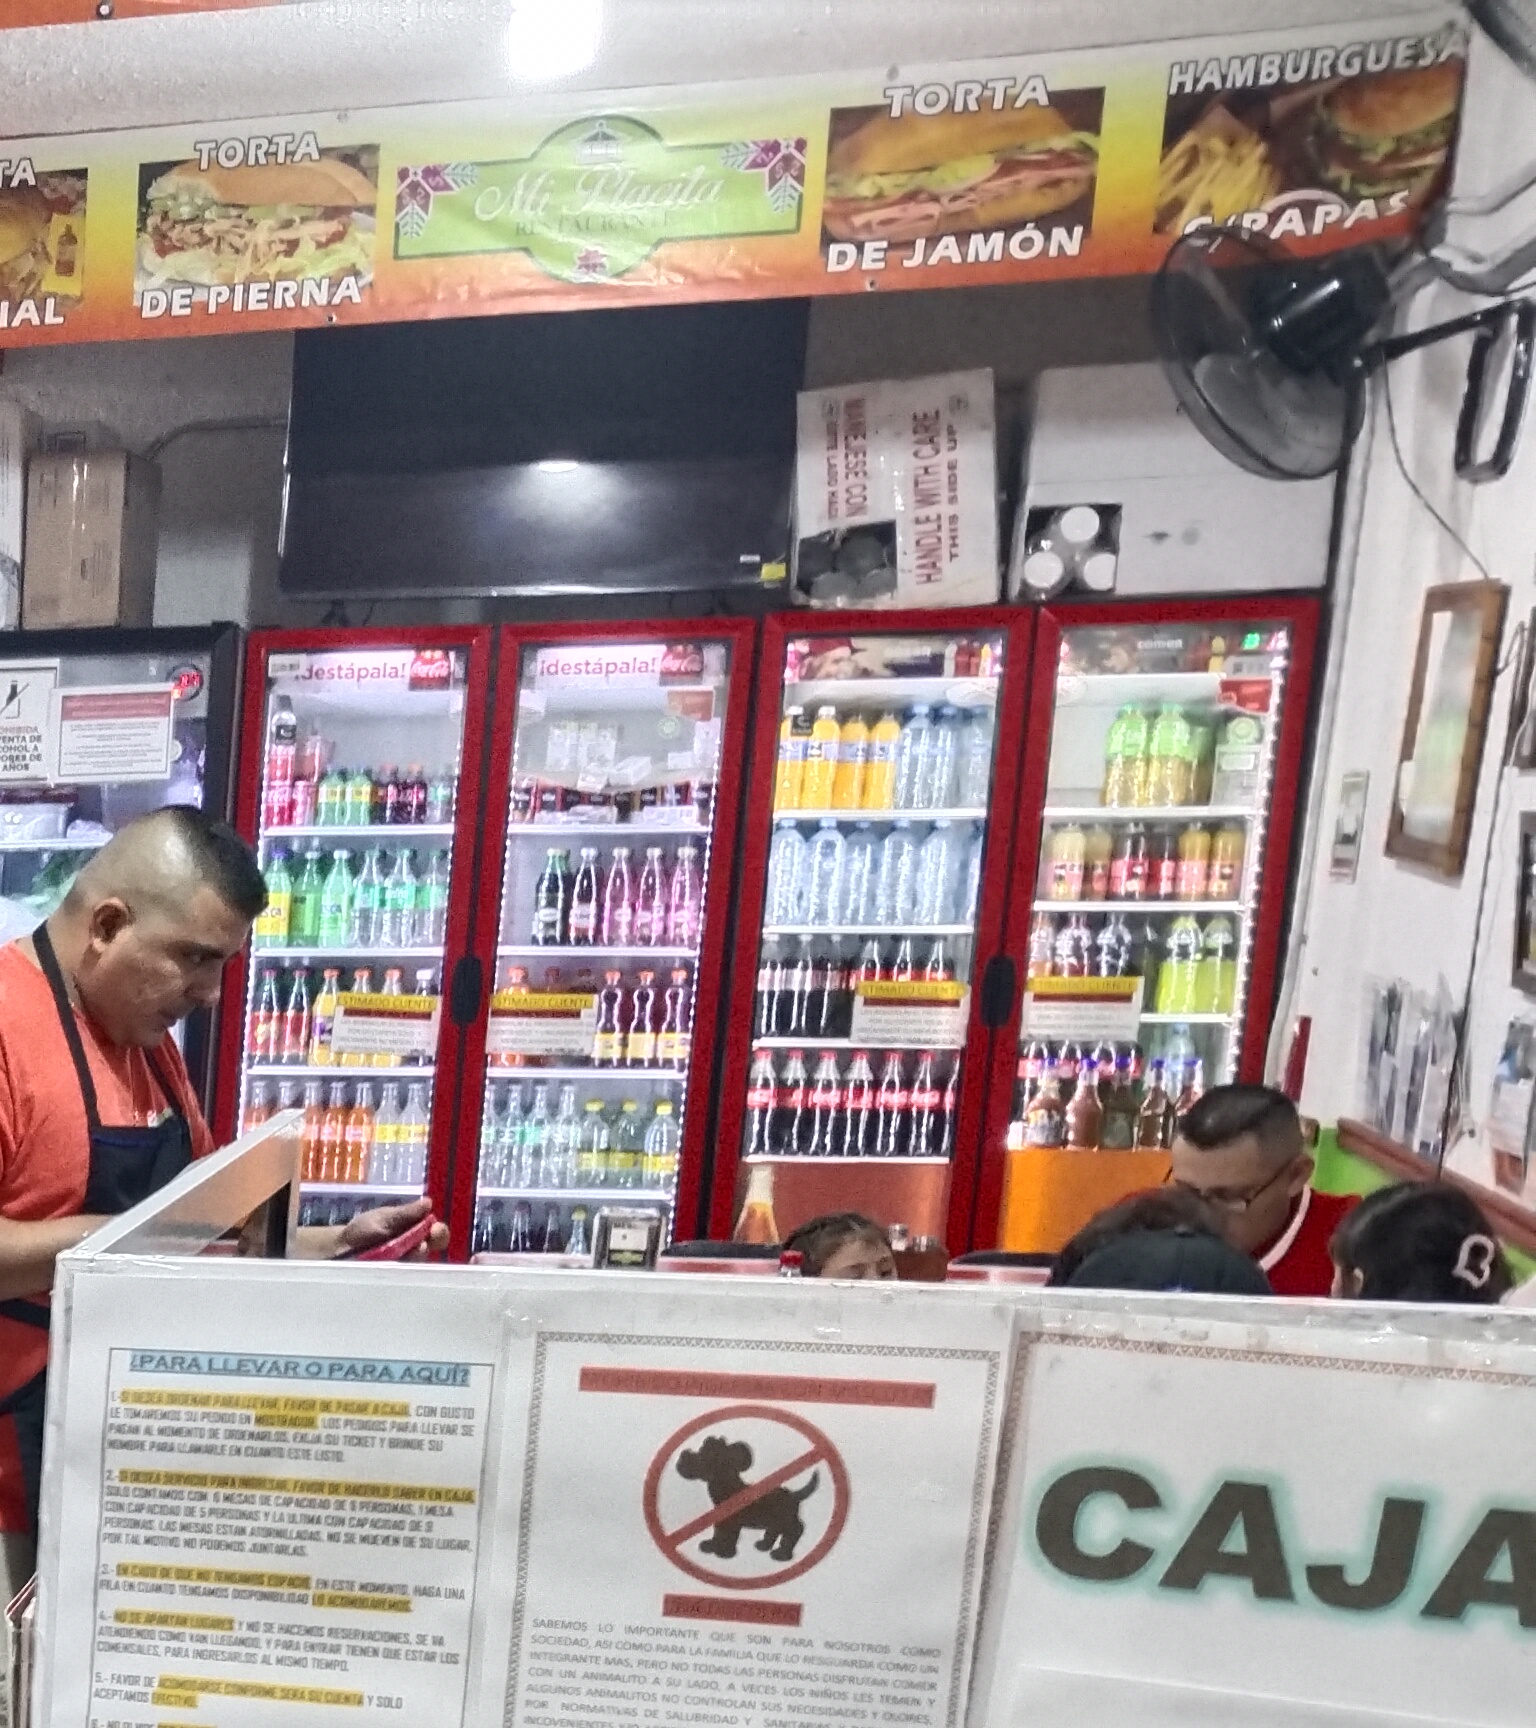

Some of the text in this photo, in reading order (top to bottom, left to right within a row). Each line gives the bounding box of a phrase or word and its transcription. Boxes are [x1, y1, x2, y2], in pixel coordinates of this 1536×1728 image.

[1167, 30, 1471, 97] HAMBURGUESA
[885, 75, 1051, 120] TORTA
[194, 132, 322, 171] TORTA
[826, 222, 1085, 274] DE JAMÓN
[141, 275, 363, 321] DE PIERNA
[913, 464, 941, 510] WITH
[947, 424, 959, 563] THIS SIDE UP
[916, 513, 943, 585] HANDLE
[131, 1354, 201, 1372] ¿PARA
[208, 1356, 298, 1376] LLEVAR
[305, 1361, 322, 1376] O
[327, 1362, 394, 1380] PARA
[1035, 1464, 1536, 1629] CAJA
[531, 1618, 589, 1633] SABEMOS
[624, 1624, 701, 1641] IMPORTANTE
